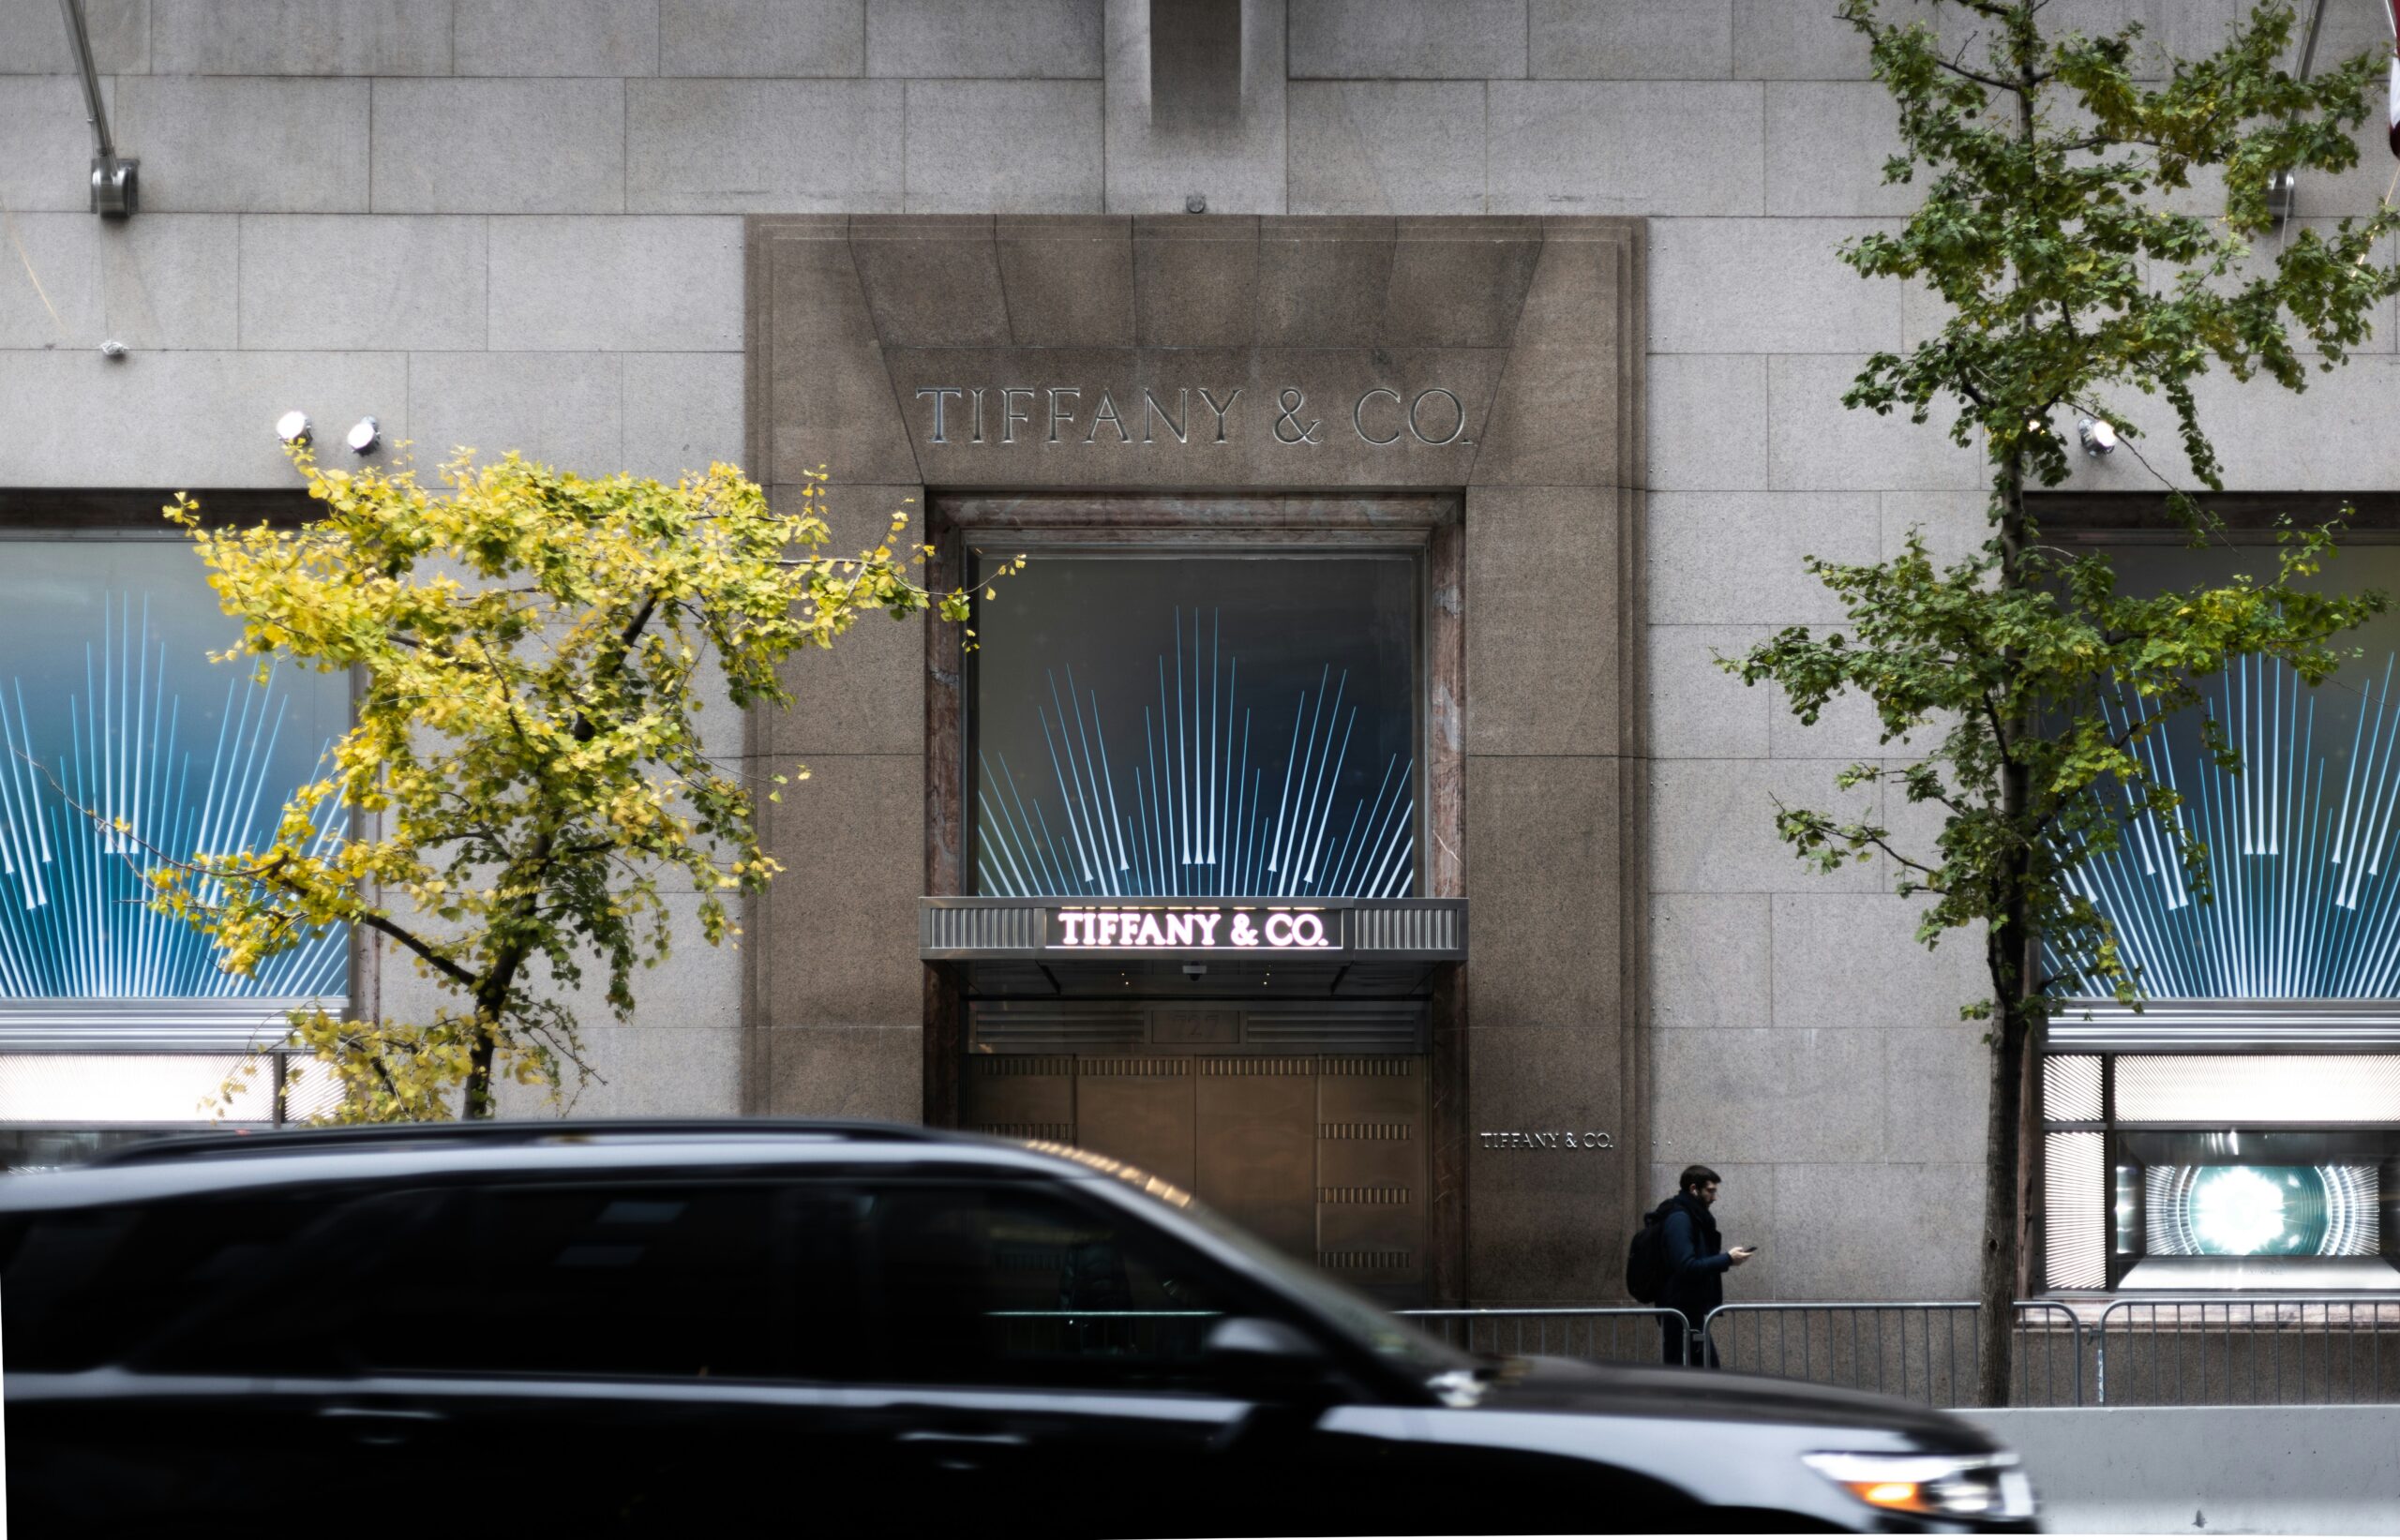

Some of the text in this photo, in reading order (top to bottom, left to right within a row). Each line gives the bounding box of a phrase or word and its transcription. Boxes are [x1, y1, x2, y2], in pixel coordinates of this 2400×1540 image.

[916, 387, 1475, 444] TIFFANY & CO.
[1058, 913, 1328, 946] TIFFANY & CO.
[1174, 1014, 1219, 1038] 727
[1480, 1132, 1613, 1148] TIFFANY & CO.
